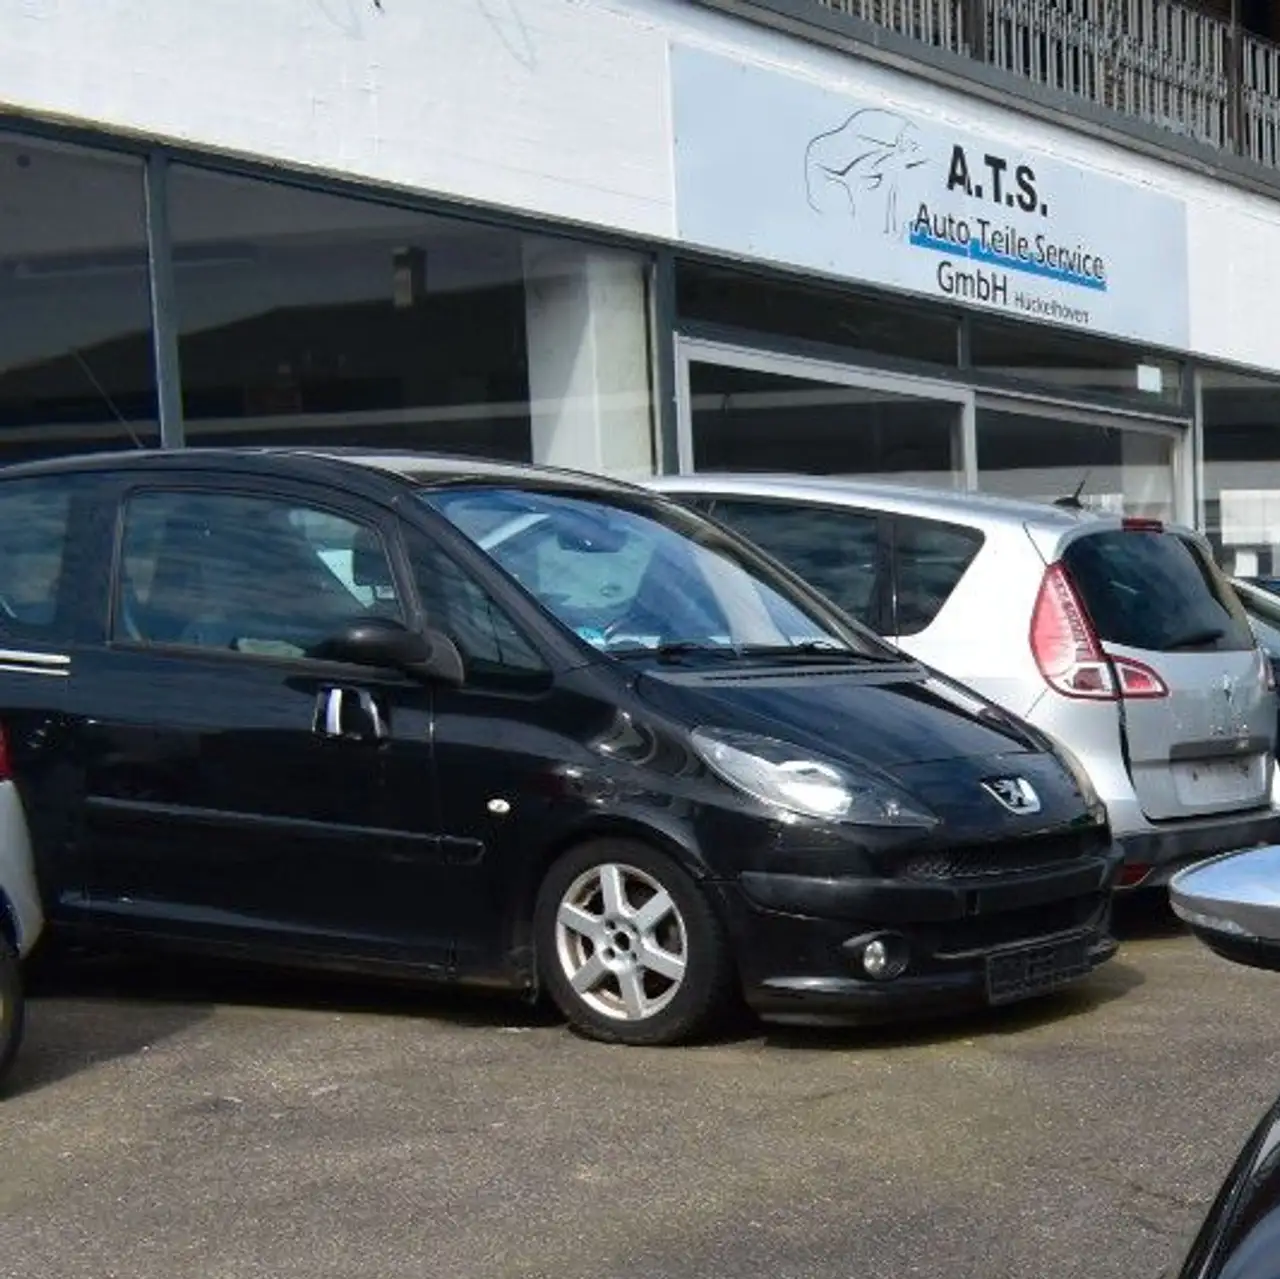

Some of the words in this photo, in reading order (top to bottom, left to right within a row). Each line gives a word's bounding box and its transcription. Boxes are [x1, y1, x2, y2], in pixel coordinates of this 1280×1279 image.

[947, 144, 1048, 217] A.T.S.
[915, 202, 971, 245] Auto
[976, 217, 1029, 261] Teile
[1034, 235, 1105, 279] Service
[937, 260, 1008, 305] GmbH
